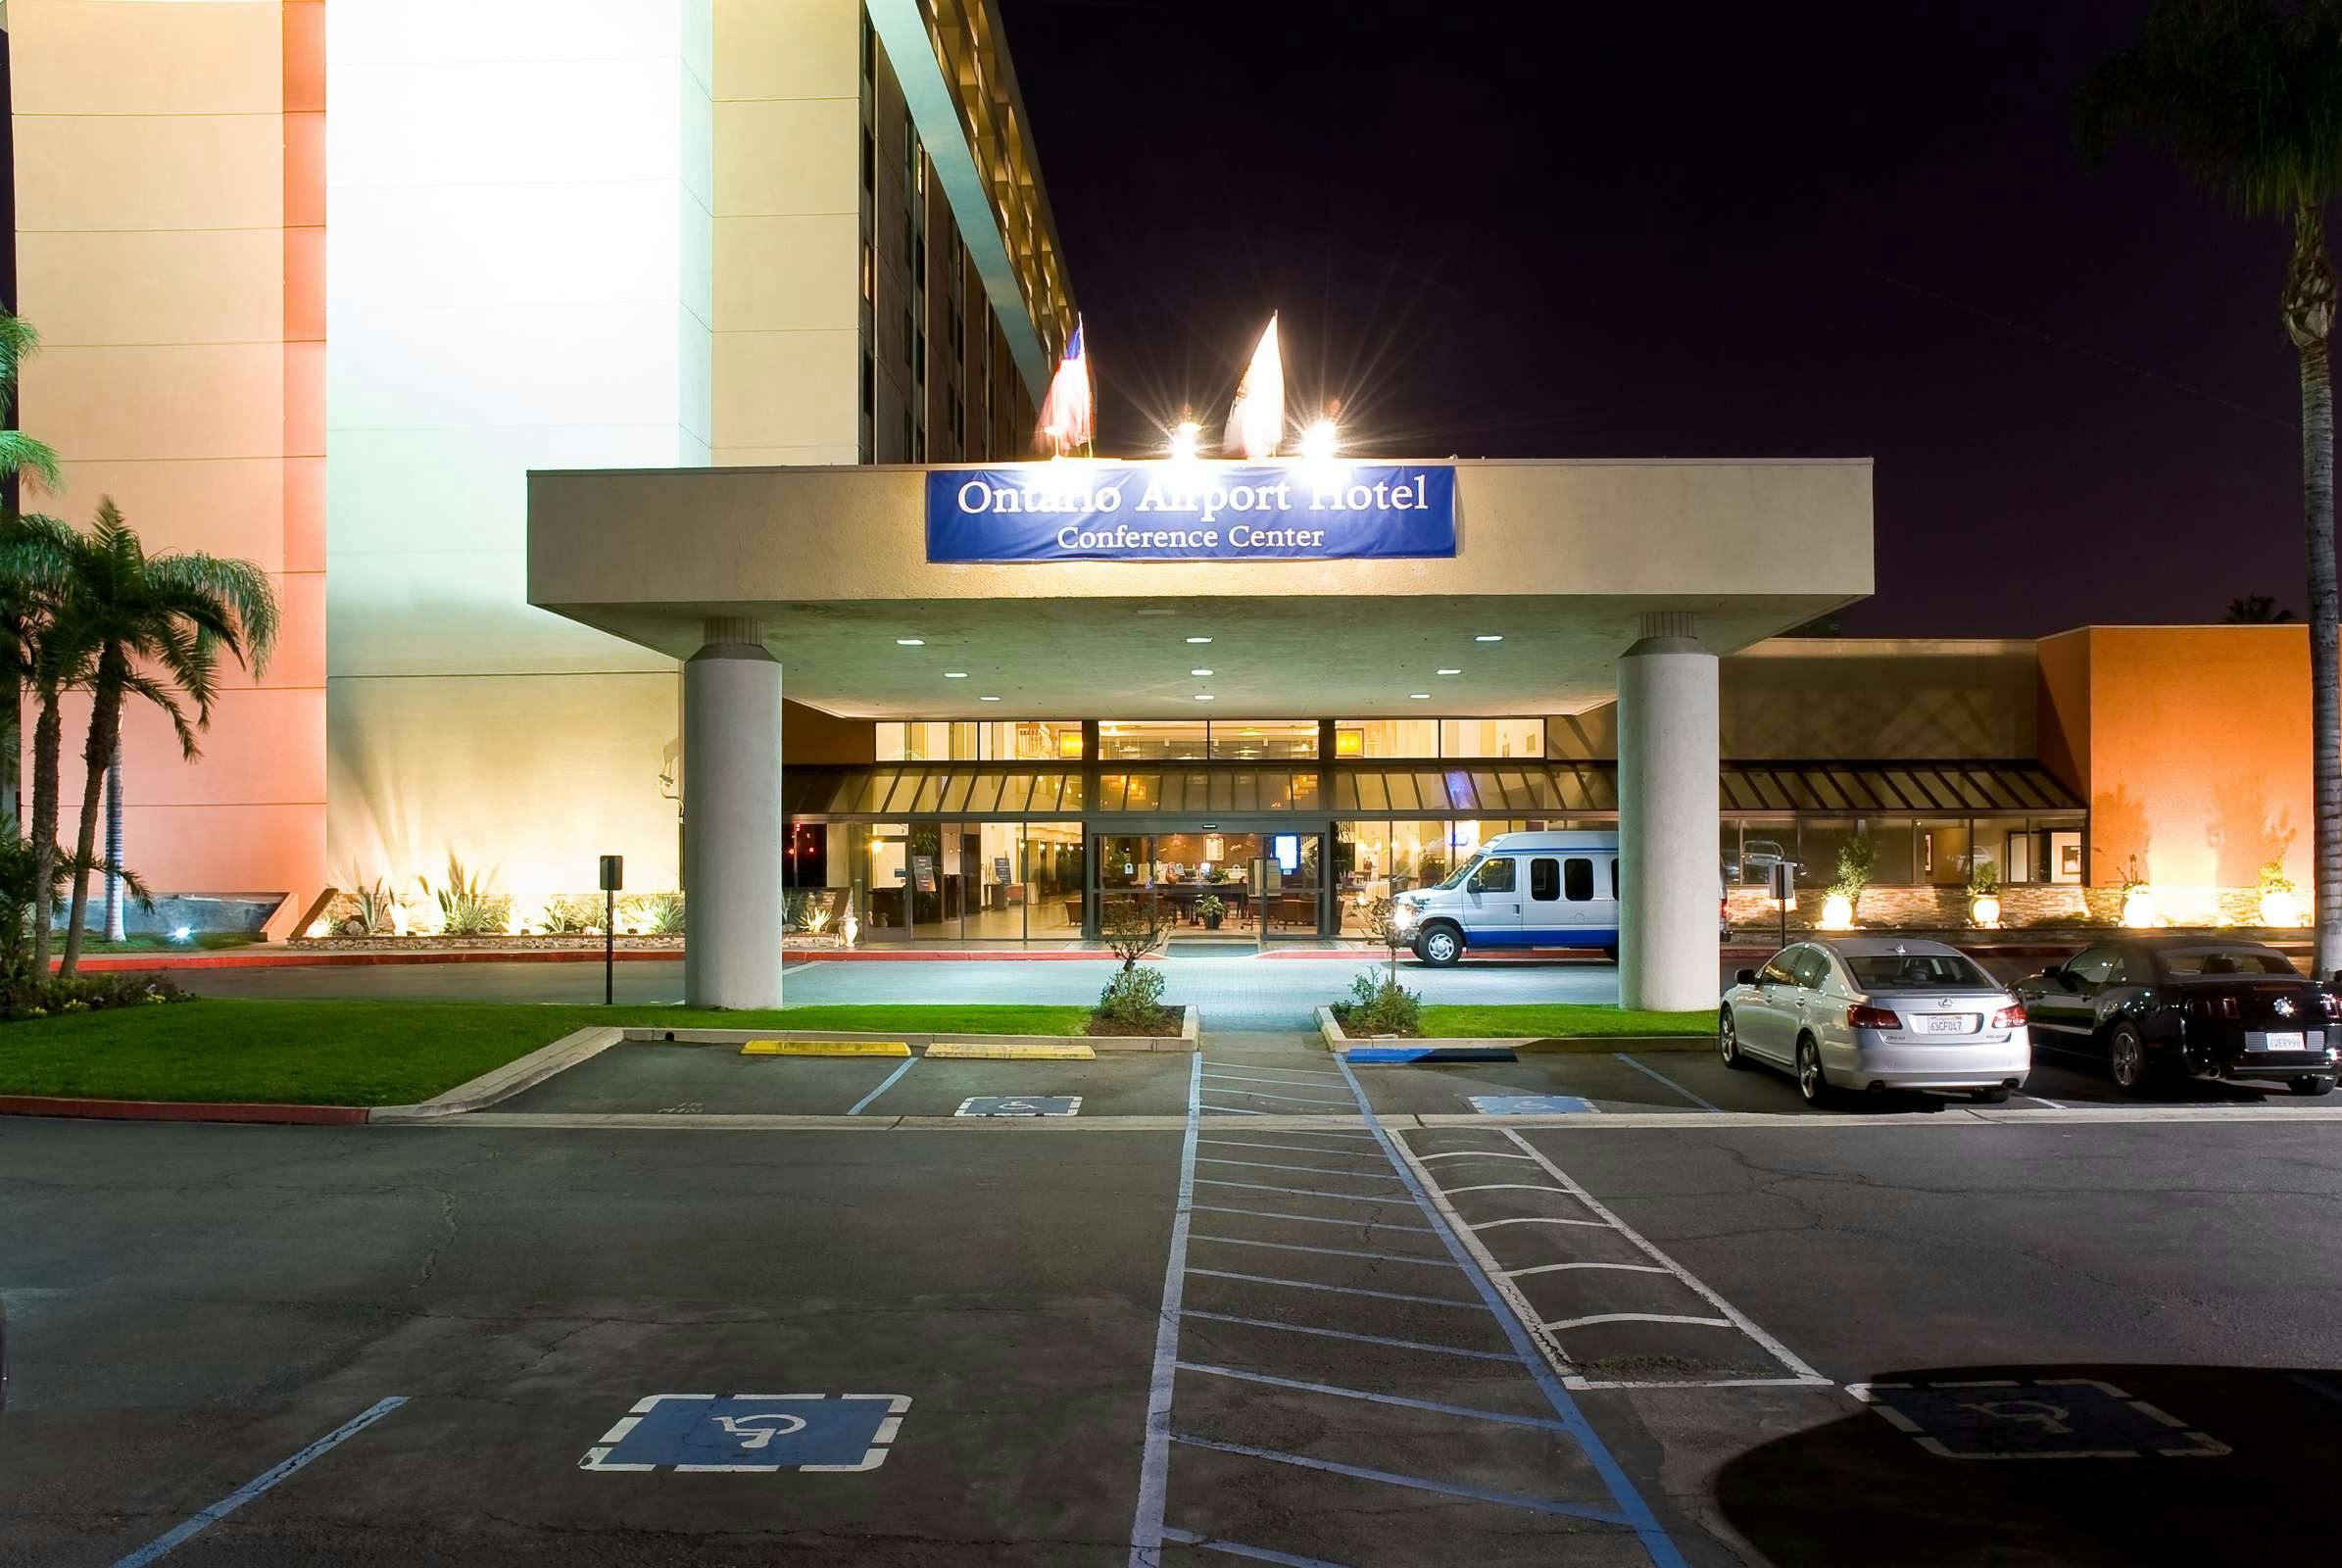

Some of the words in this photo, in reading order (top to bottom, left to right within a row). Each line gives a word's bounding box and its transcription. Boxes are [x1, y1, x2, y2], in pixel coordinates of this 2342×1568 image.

[957, 479, 1122, 514] Ontario
[1135, 474, 1292, 522] Airport
[1308, 473, 1429, 511] Hotel
[1056, 524, 1219, 549] Conference
[1228, 524, 1325, 548] Center
